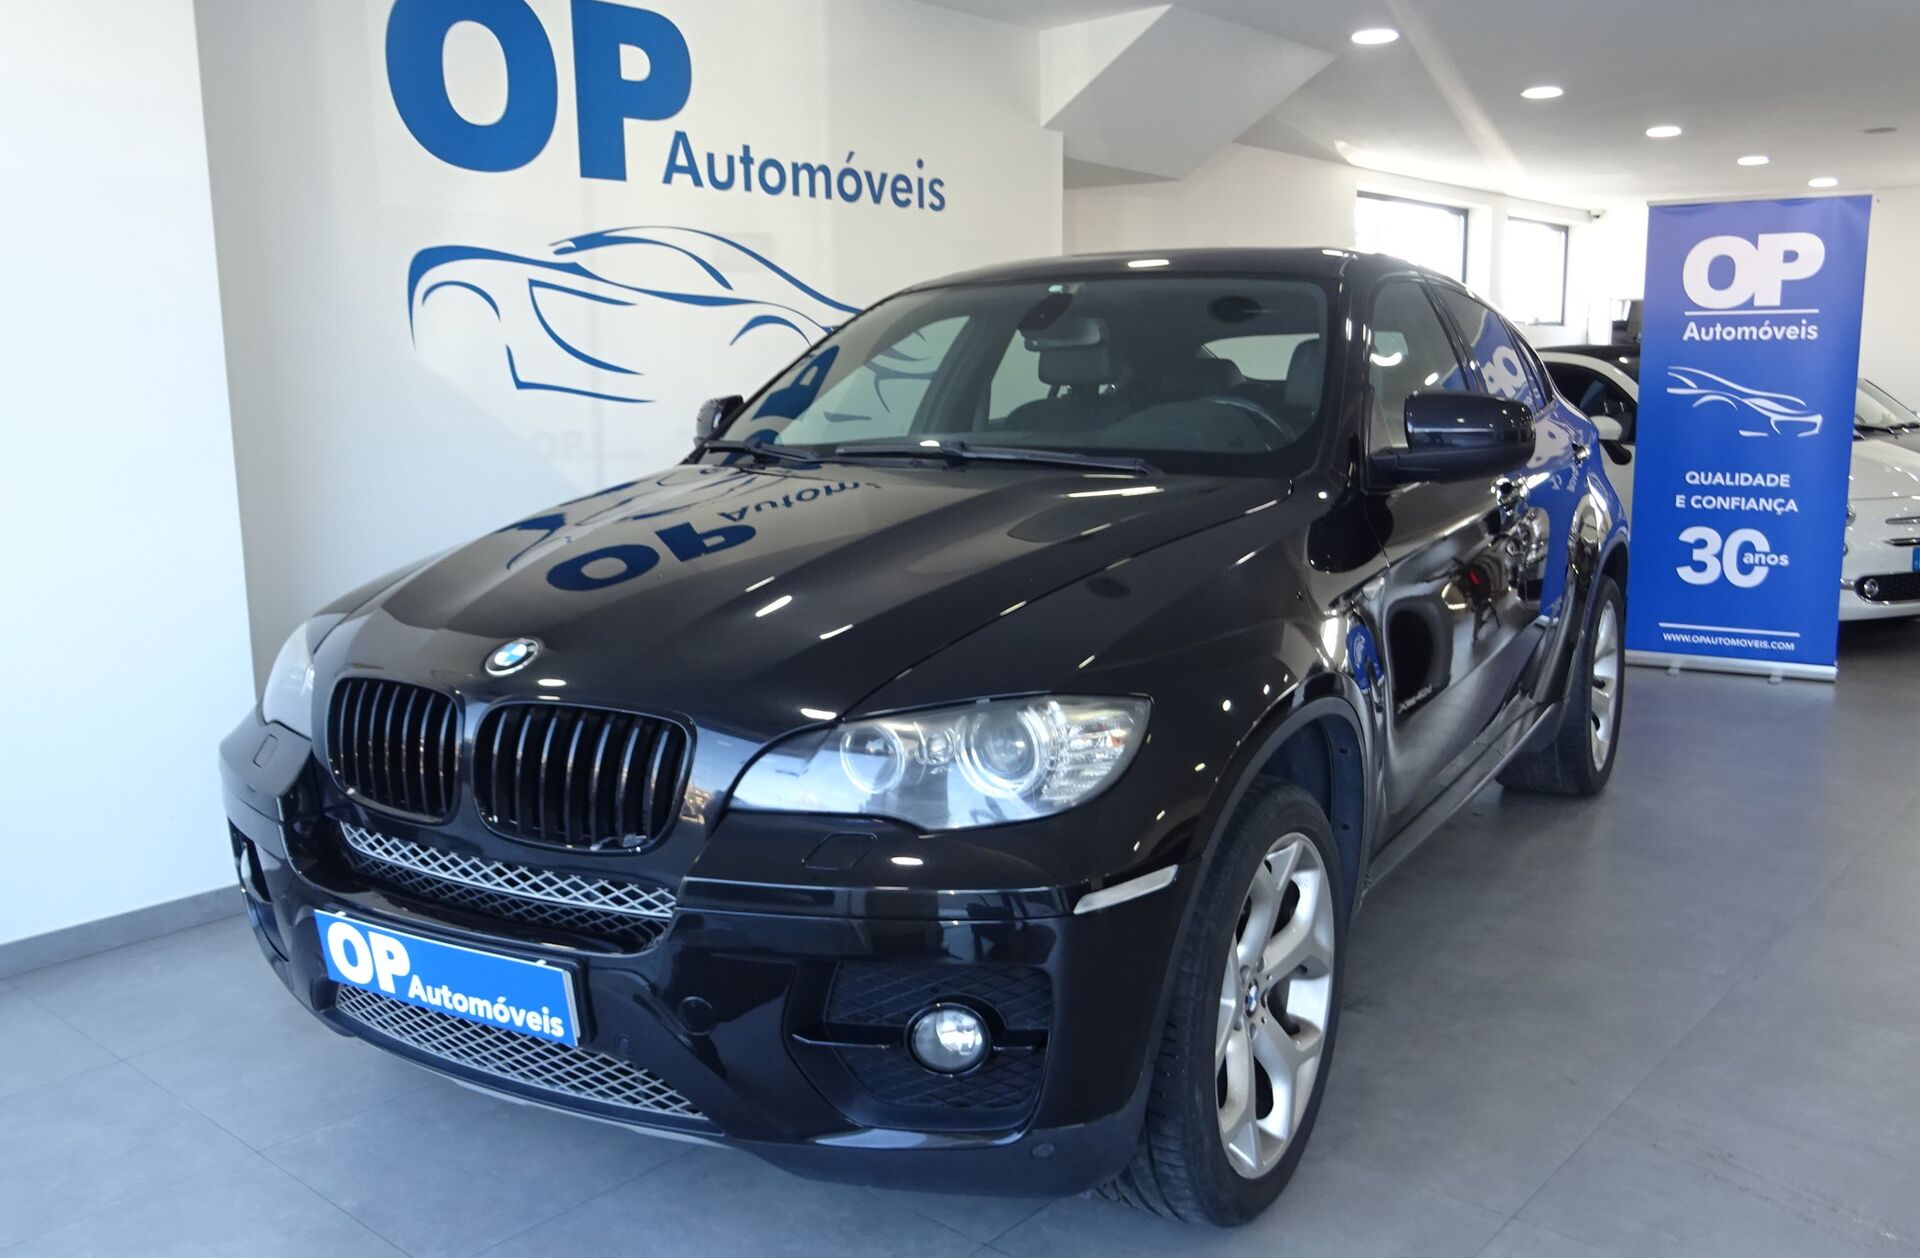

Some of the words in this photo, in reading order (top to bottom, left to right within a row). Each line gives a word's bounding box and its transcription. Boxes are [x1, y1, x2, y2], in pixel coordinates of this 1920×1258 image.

[385, 0, 692, 181] OP
[662, 130, 946, 212] Automóveis
[1682, 232, 1826, 309] OP
[1682, 318, 1819, 342] Automóveis
[1675, 494, 1686, 509] E
[1690, 495, 1799, 516] CONFIANÇA
[1685, 470, 1791, 488] QUALIDADE
[1676, 525, 1771, 588] 30
[1743, 552, 1789, 566] anos
[1662, 632, 1796, 651] WWW.OPAUTOMOVEIS.COM
[327, 921, 411, 994] OP
[408, 974, 565, 1037] Automóveis
